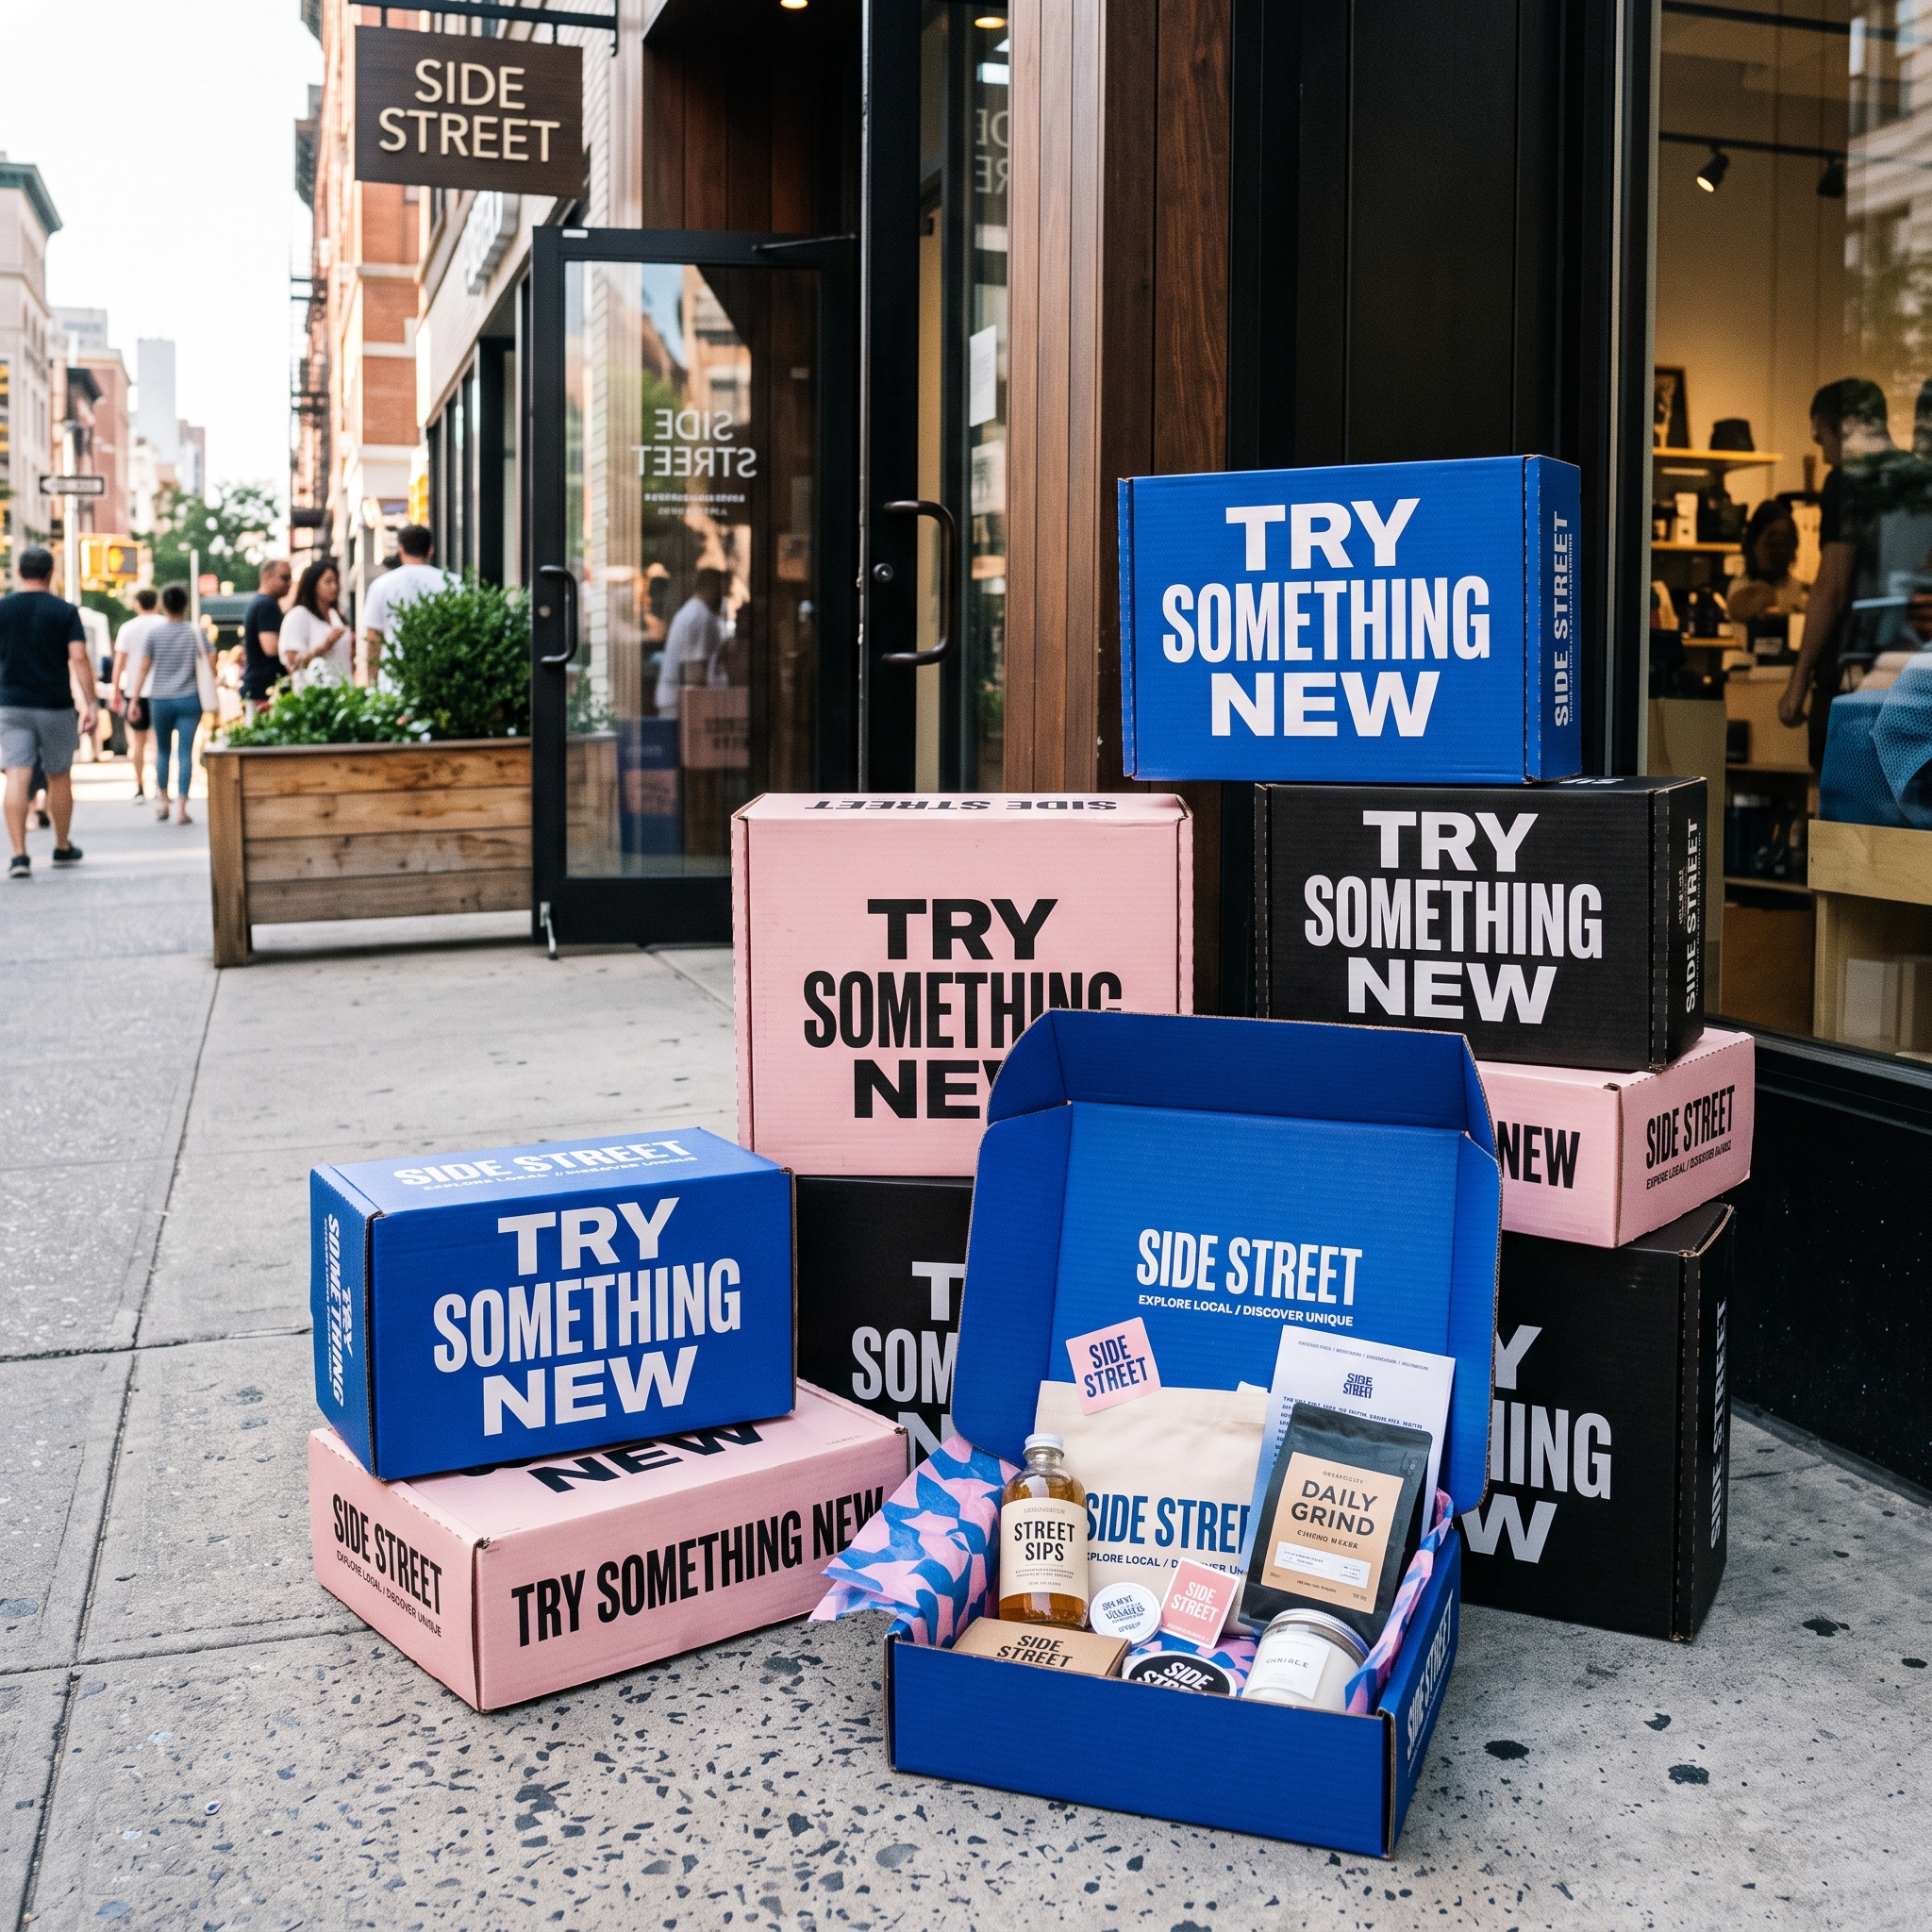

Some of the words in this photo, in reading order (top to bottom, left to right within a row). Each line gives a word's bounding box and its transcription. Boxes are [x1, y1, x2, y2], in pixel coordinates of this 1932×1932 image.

[415, 58, 525, 109] SIDE
[379, 108, 560, 162] STREET
[1226, 498, 1421, 571] TRY
[1555, 511, 1568, 640] STREET
[1162, 575, 1491, 663] SOMETHING
[1211, 671, 1441, 737] NEW
[1555, 651, 1568, 726] SIDE
[805, 801, 991, 809] STREET
[1006, 801, 1117, 810] SIDE
[1363, 810, 1539, 873] TRY
[1687, 819, 1698, 934] STREET
[867, 899, 1058, 960] TRY
[1305, 874, 1602, 959] SOMETHING
[1348, 957, 1557, 1024] NEW
[1686, 940, 1697, 1013] SIDE
[854, 1059, 1006, 1119] NE
[1497, 1121, 1581, 1189] NEW
[1646, 1108, 1679, 1169] SIDE
[1684, 1084, 1735, 1152] STREET
[392, 1159, 513, 1186] SIDE
[513, 1140, 691, 1173] STREET
[497, 1197, 680, 1276] TRY
[1137, 1228, 1219, 1291] SIDE
[1225, 1237, 1362, 1306] STREET
[328, 1213, 343, 1407] SOMETHING
[433, 1257, 741, 1374] SOMETHING
[1139, 1294, 1191, 1309] EXPLORE
[1193, 1300, 1233, 1314] LOCAL
[1234, 1304, 1241, 1316] /
[1242, 1306, 1304, 1322] DISCOVER
[1306, 1312, 1354, 1327] UNIQUE
[1084, 1357, 1148, 1397] STREET
[1089, 1335, 1131, 1369] SIDE
[1712, 1296, 1727, 1455] STREET
[482, 1345, 699, 1437] NEW
[527, 1424, 764, 1493] NEW
[1085, 1492, 1148, 1544] SIDE
[1155, 1497, 1251, 1554] STRE
[1291, 1502, 1374, 1536] GRIND
[1302, 1479, 1378, 1512] DAILY
[1710, 1457, 1723, 1548] SIDE
[333, 1493, 371, 1564] SIDE
[375, 1524, 441, 1615] STREET
[1014, 1521, 1074, 1542] STREET
[1025, 1542, 1064, 1561] SIPS
[1088, 1552, 1124, 1564] PLORE
[1126, 1556, 1160, 1567] LOCAL
[1163, 1558, 1169, 1568] /
[511, 1569, 586, 1647] TRY
[596, 1509, 803, 1624] SOMETHING
[1171, 1593, 1220, 1623] STREET
[1185, 1581, 1217, 1604] SIDE
[996, 1645, 1074, 1668] STREET
[1017, 1635, 1064, 1652] SIDE
[1163, 1661, 1214, 1690] SIDE
